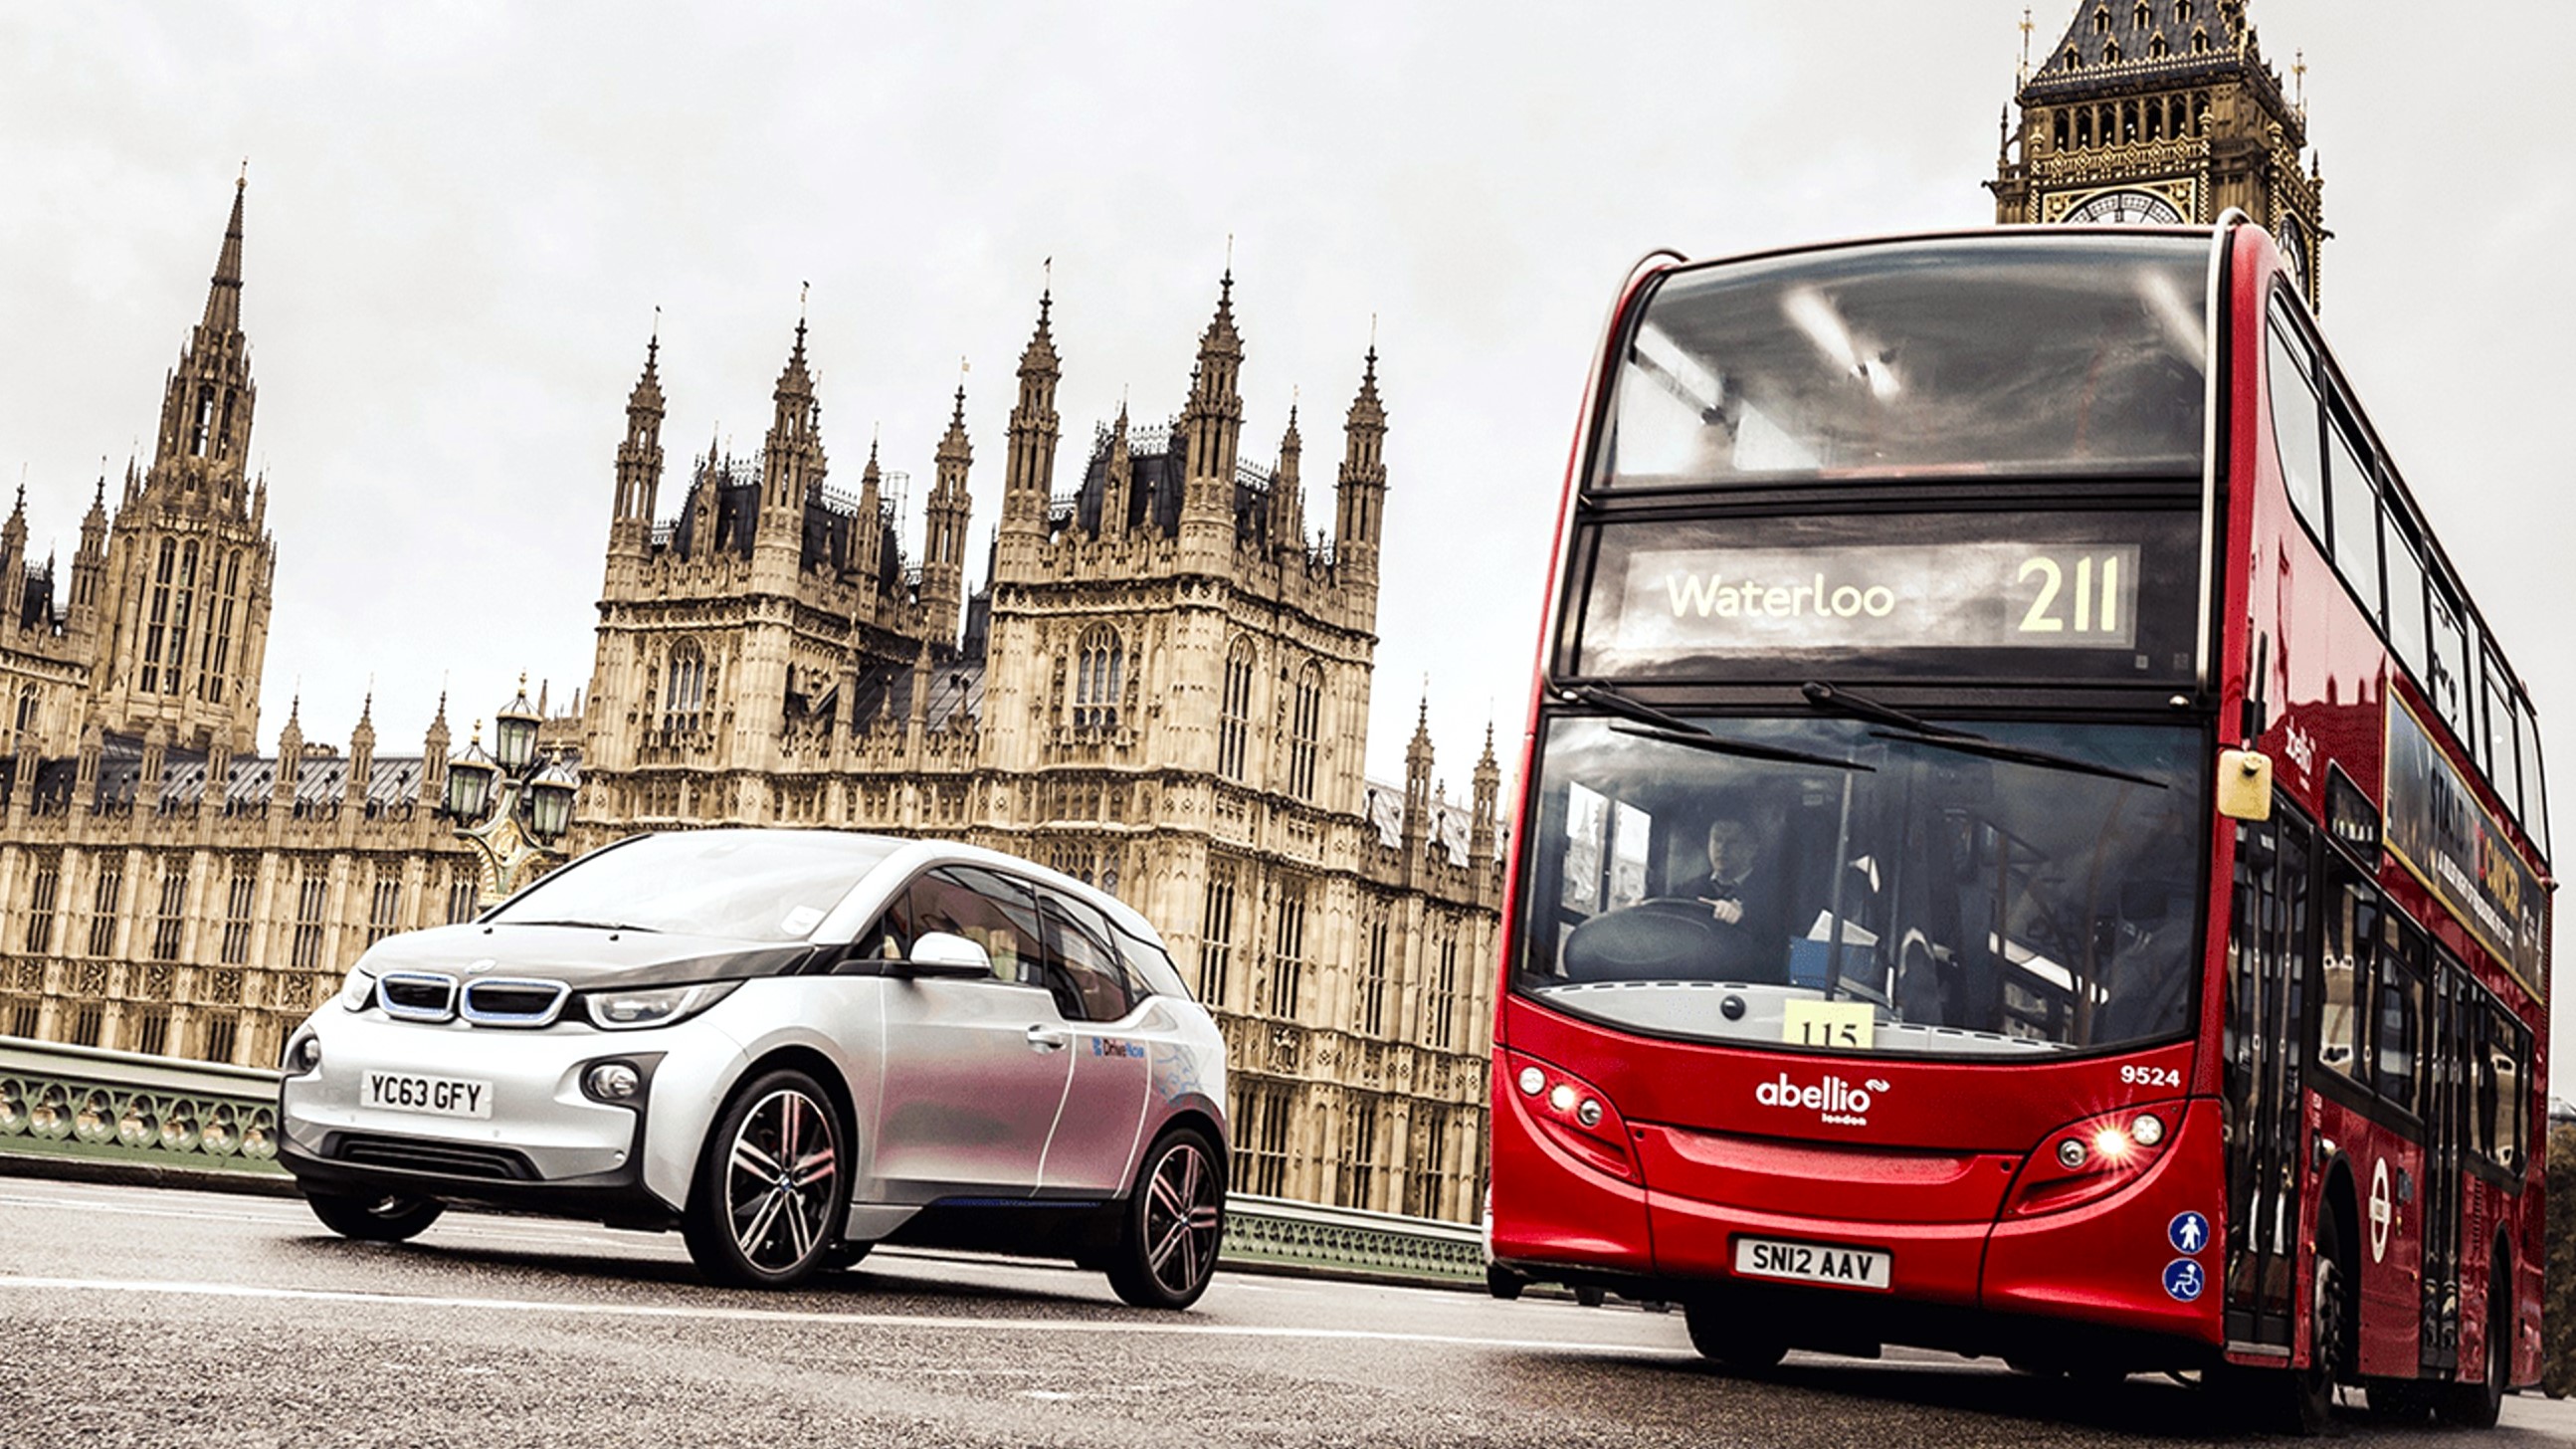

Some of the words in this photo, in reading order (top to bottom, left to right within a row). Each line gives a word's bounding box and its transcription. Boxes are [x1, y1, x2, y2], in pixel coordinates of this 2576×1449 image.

[1666, 573, 1894, 617] Waterloo
[2018, 555, 2118, 632] 211
[1802, 1021, 1858, 1046] 115
[371, 1075, 428, 1107] YC63
[434, 1081, 482, 1112] GFY
[1755, 1072, 1871, 1113] abellio
[2120, 1065, 2181, 1088] 9524
[1822, 1113, 1867, 1126] london
[1753, 1244, 1812, 1274] SN12
[1820, 1251, 1873, 1281] AAV
